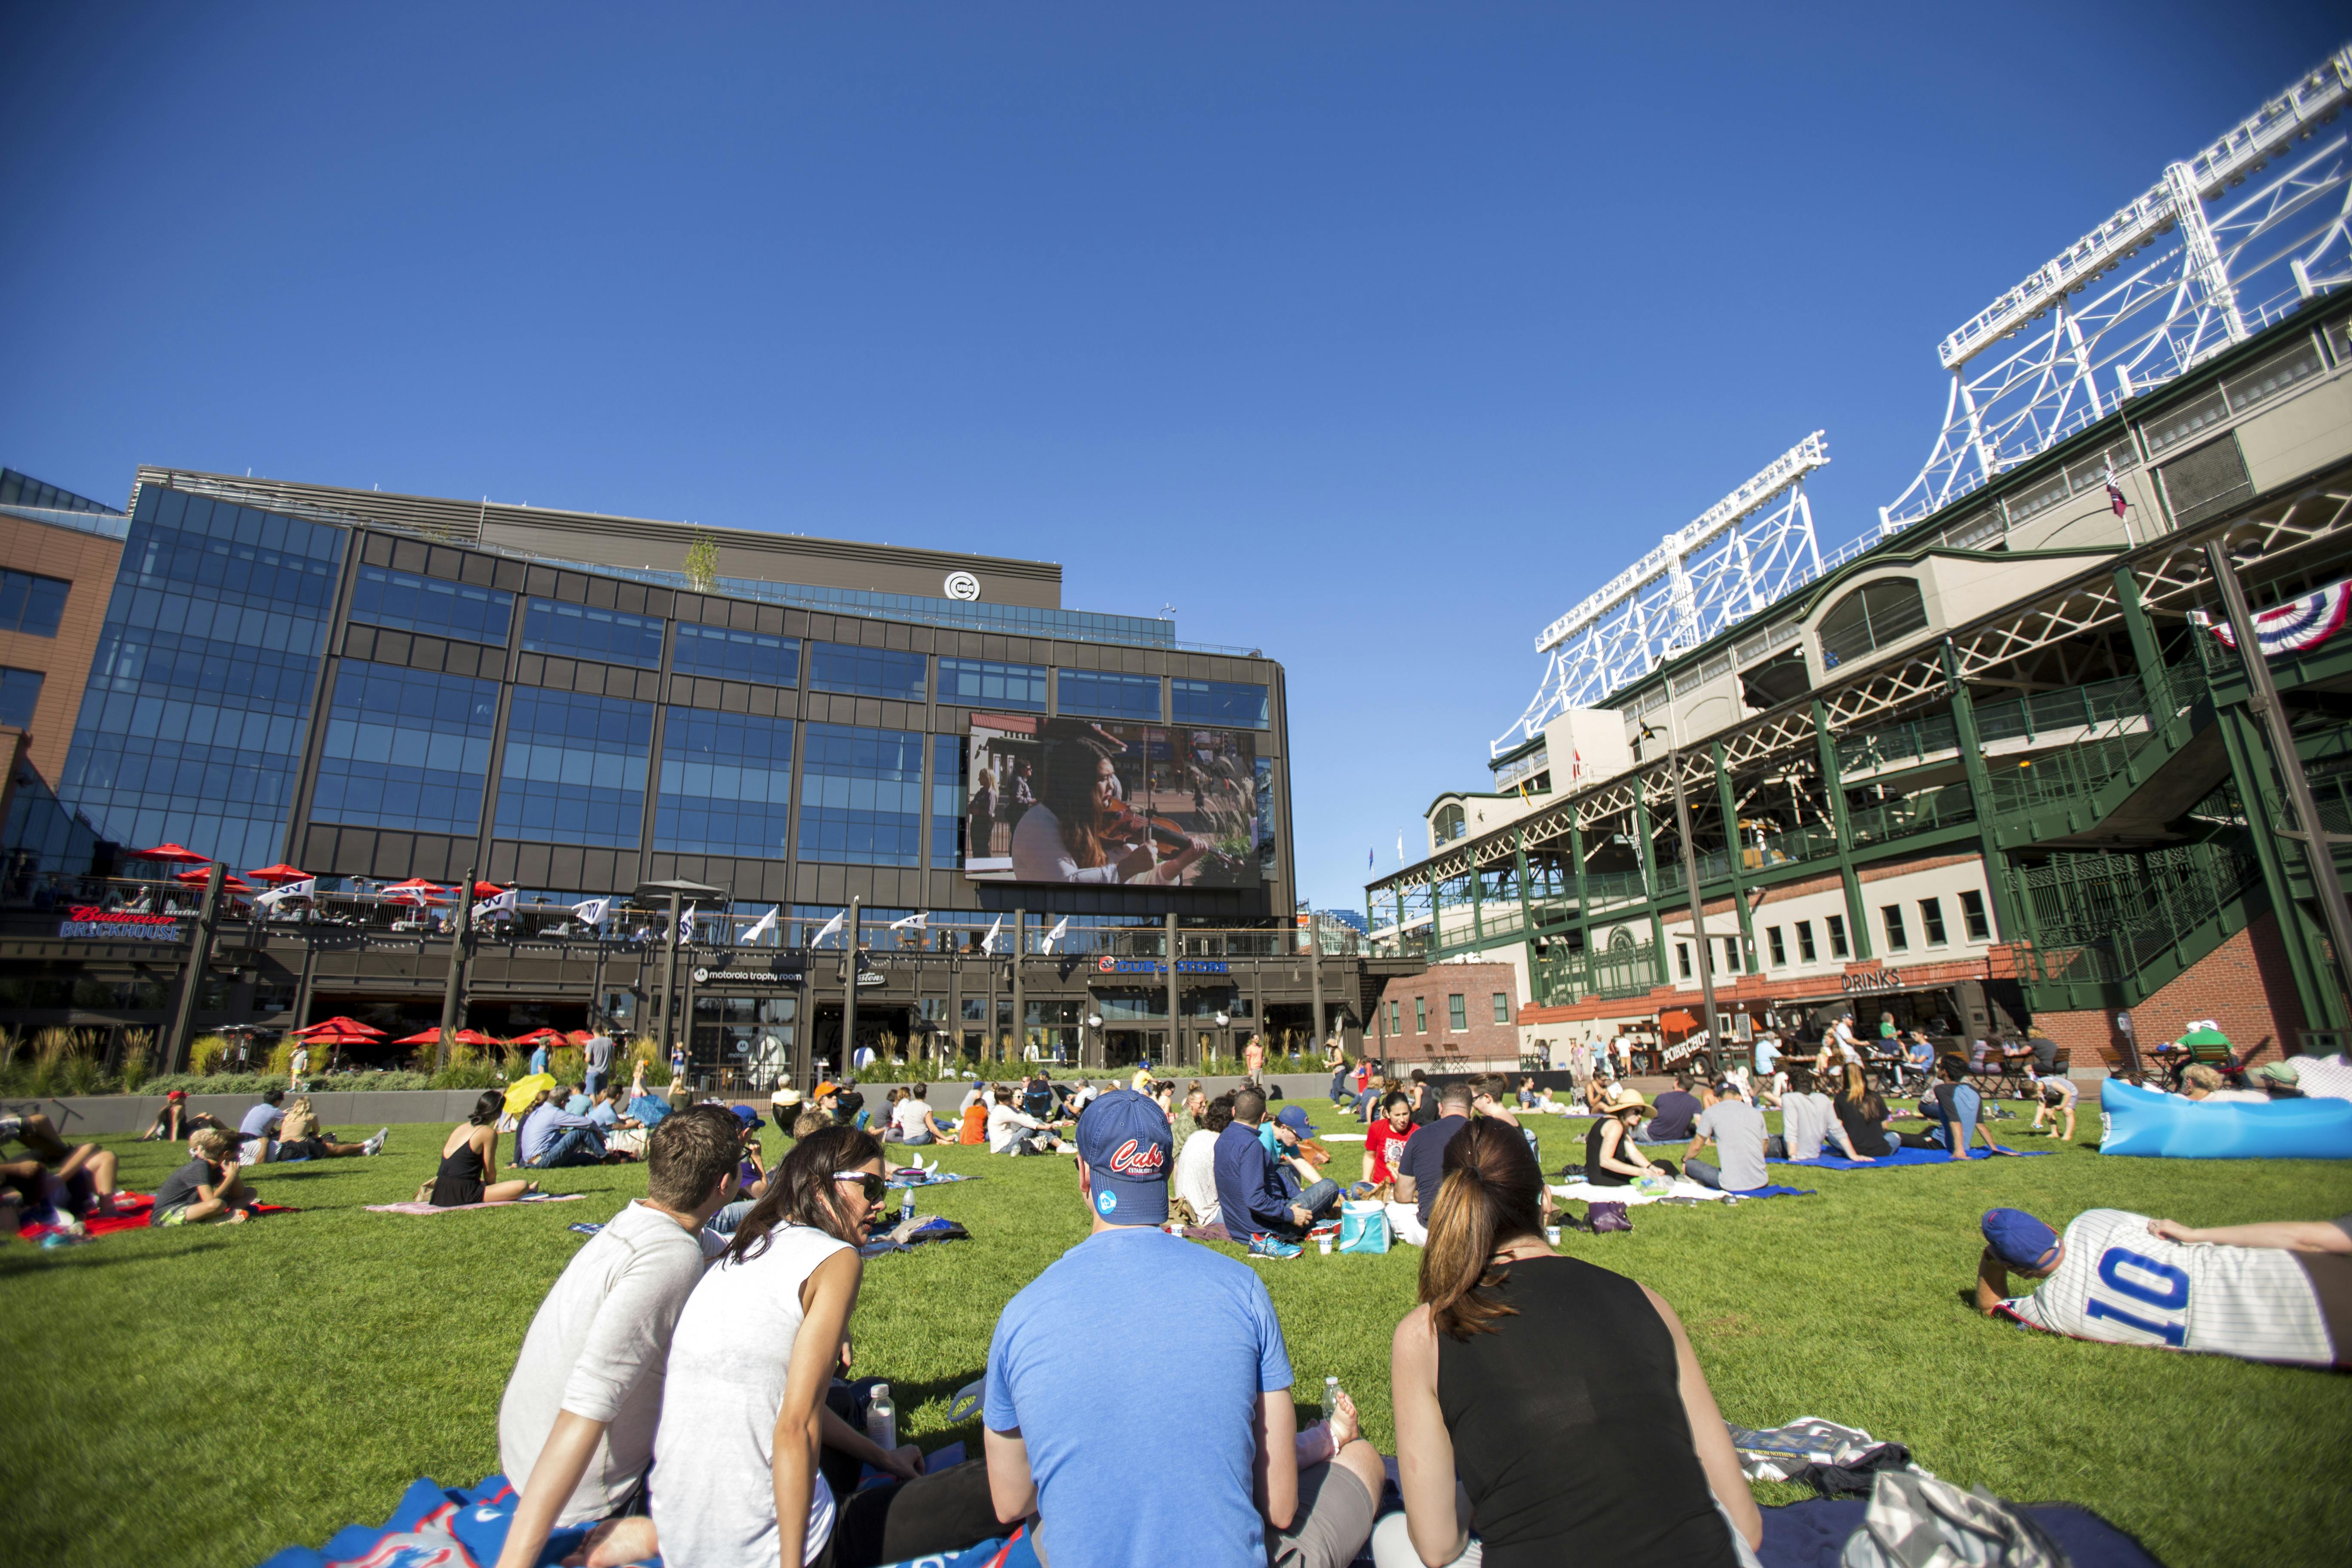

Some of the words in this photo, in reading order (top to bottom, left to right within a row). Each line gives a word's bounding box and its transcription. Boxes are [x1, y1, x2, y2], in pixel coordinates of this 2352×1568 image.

[70, 906, 178, 925] Budweiser
[709, 971, 748, 980] motorola
[750, 971, 778, 982] trophy
[779, 973, 802, 981] room
[1117, 960, 1168, 972] CUBS
[1177, 961, 1228, 973] STORE
[1842, 968, 1902, 990] DRINKS
[1110, 1139, 1164, 1172] Cubs
[2087, 1246, 2190, 1347] 10
